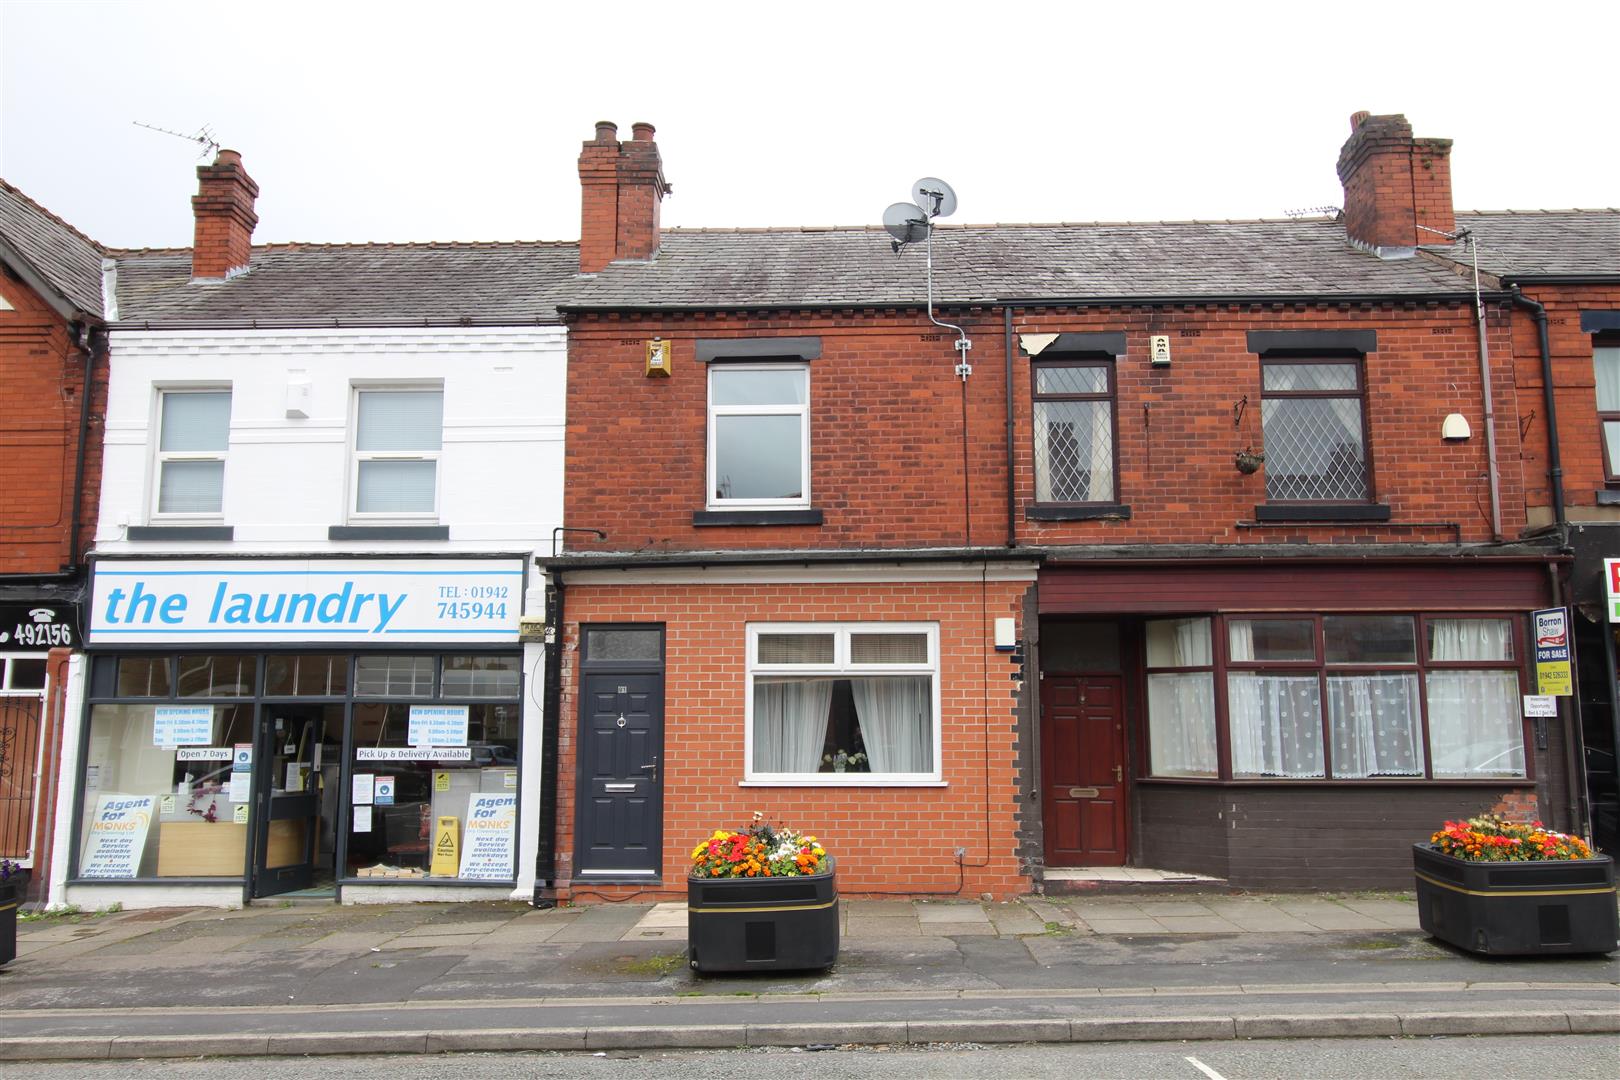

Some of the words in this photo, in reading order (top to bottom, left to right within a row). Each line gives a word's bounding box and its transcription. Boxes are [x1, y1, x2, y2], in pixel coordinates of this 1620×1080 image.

[471, 586, 508, 598] 01942
[104, 582, 188, 624] the
[208, 581, 408, 633] laundry
[438, 602, 508, 619] 745944
[1538, 617, 1562, 627] Borron
[14, 624, 71, 645] 492156
[1538, 650, 1550, 660] FOR
[1551, 649, 1567, 659] SALE
[181, 750, 200, 759] Open
[377, 750, 388, 759] Up
[398, 750, 430, 759] Delivery
[104, 798, 150, 810] Agent
[102, 812, 125, 821] for
[474, 810, 496, 818] for
[94, 822, 136, 830] MONKS
